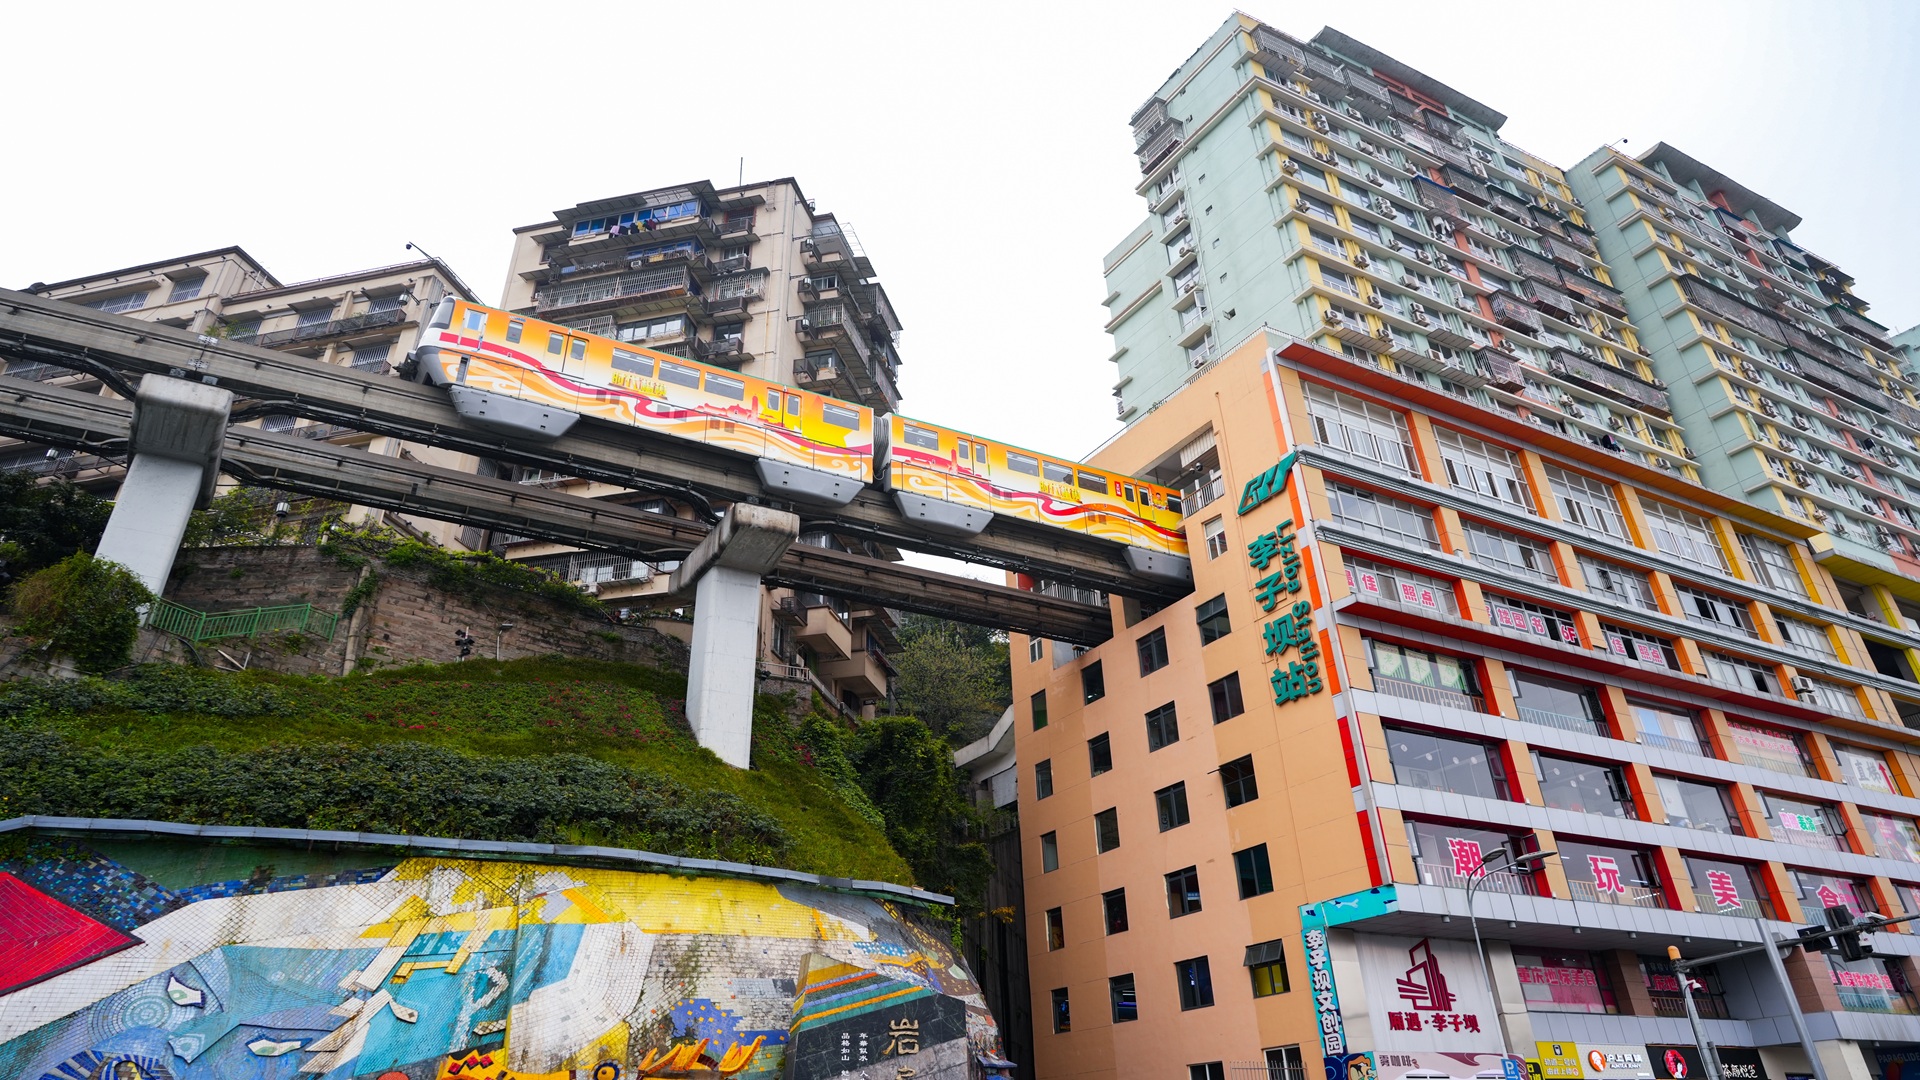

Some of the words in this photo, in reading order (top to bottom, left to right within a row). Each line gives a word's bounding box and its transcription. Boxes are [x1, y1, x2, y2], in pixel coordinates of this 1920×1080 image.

[1248, 531, 1309, 706] 李子坝站
[1276, 519, 1301, 594] Liziba
[1292, 600, 1323, 695] Station
[1560, 624, 1576, 643] 6F
[1448, 838, 1486, 878] 潮
[1589, 855, 1625, 893] 玩
[1707, 870, 1742, 908] 美
[1305, 929, 1344, 1056] 李子坝文创园
[1516, 967, 1597, 986] 重庆地标美食
[1505, 1061, 1514, 1075] P
